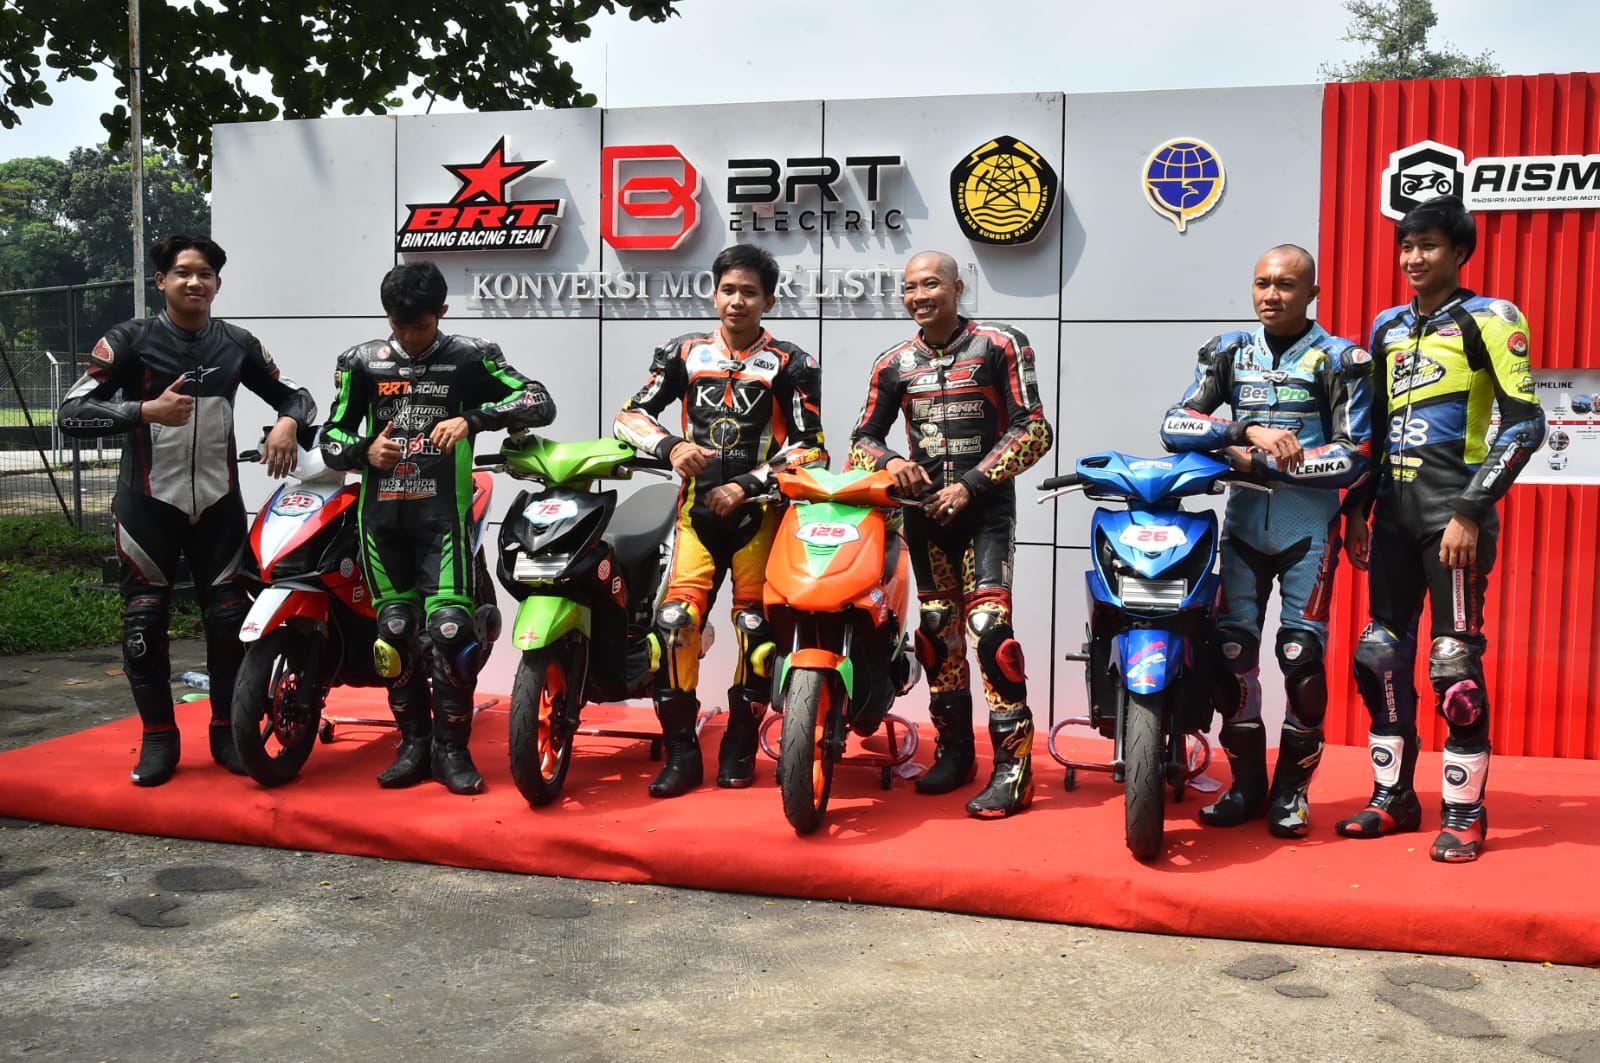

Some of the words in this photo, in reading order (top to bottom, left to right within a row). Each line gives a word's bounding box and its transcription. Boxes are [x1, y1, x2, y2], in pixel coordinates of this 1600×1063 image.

[727, 155, 901, 203] BRT
[407, 203, 556, 230] BRT
[958, 182, 967, 213] ENERGI
[964, 215, 978, 230] DAN
[979, 226, 1012, 240] SUMBER
[1014, 223, 1034, 237] DAYA
[1033, 185, 1048, 222] MINERAL
[729, 209, 904, 232] ELECTRIC
[401, 231, 458, 247] BINTANG
[457, 229, 509, 246] RACING
[508, 228, 546, 246] TEAM
[471, 271, 649, 299] KONVERSI
[660, 270, 798, 298] MOR
[1240, 386, 1310, 402] BesPro
[1167, 420, 1204, 431] LENKA
[1296, 461, 1346, 475] LENKA
[381, 479, 401, 487] BOS
[536, 504, 561, 515] 75
[810, 526, 846, 538] 128
[1136, 530, 1168, 543] 26
[1384, 670, 1397, 723] BLESSING
